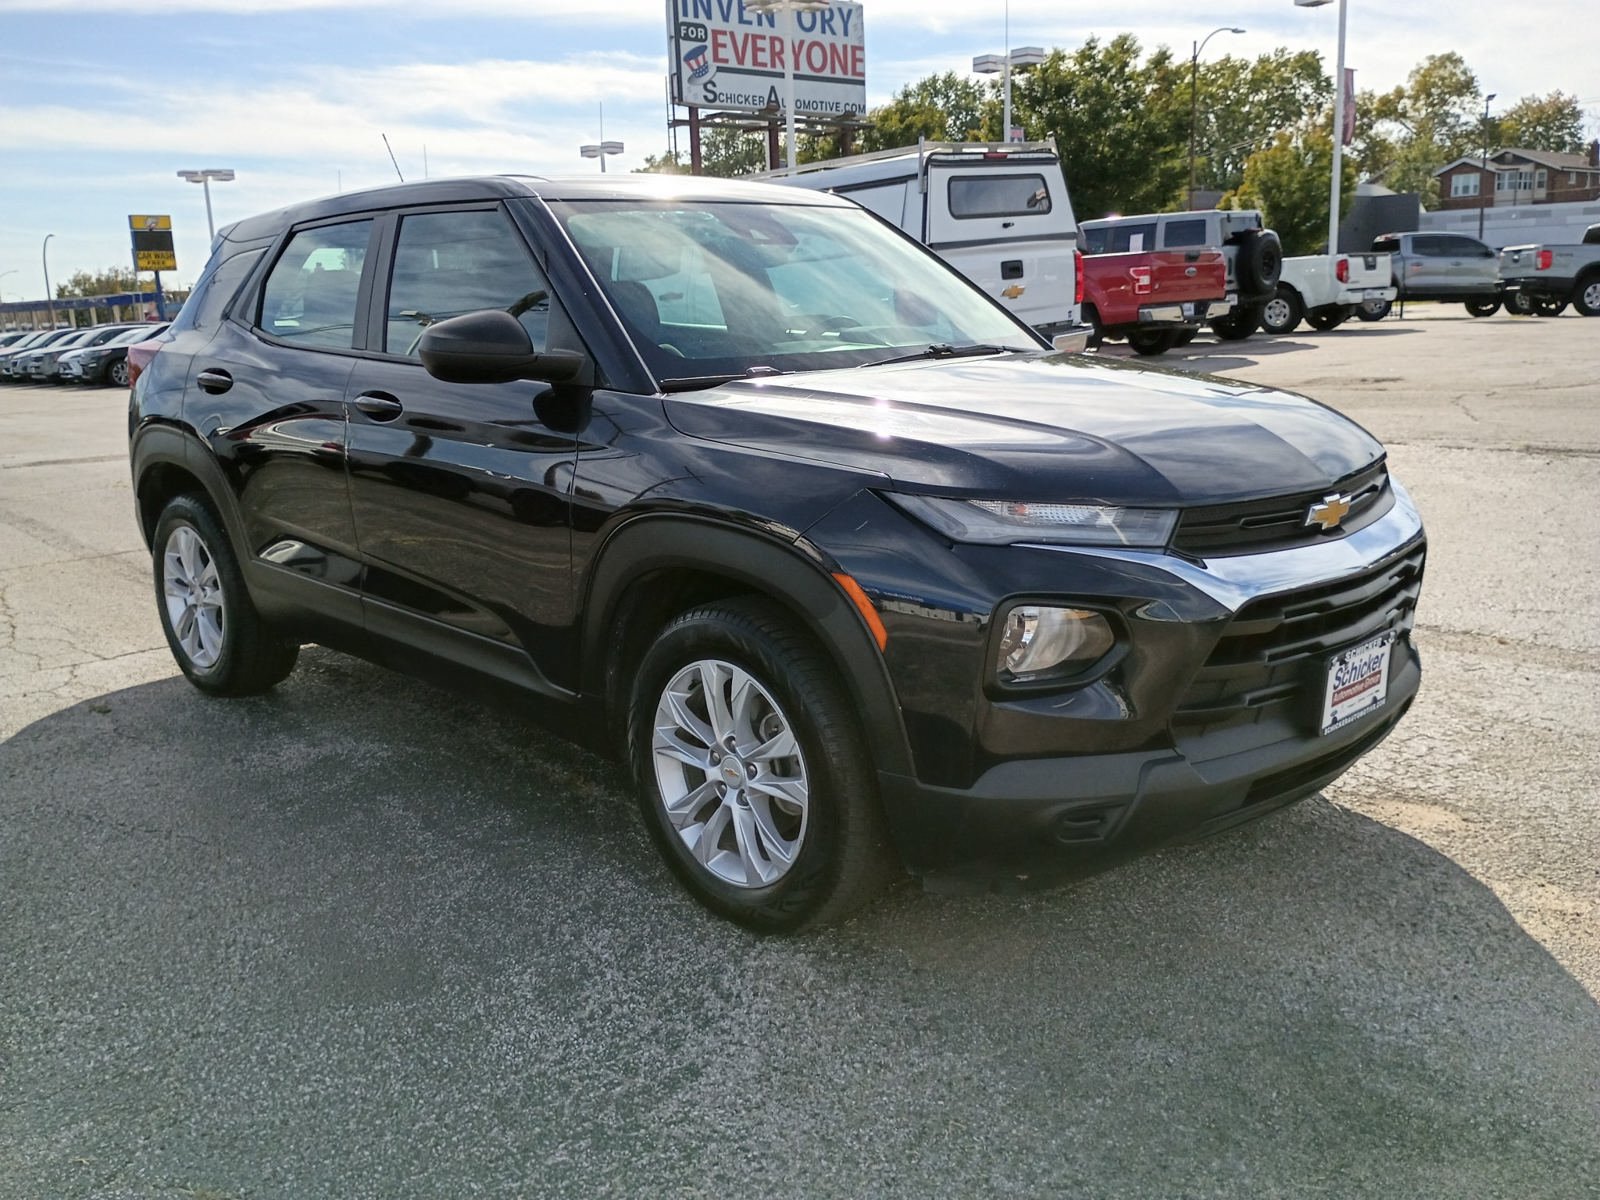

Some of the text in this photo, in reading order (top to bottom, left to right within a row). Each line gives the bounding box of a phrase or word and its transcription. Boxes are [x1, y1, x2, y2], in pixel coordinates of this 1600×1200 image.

[680, 25, 706, 40] FOR
[681, 0, 853, 37] INVENORY
[711, 29, 865, 77] EVERYONE
[1333, 652, 1385, 690] Schicker
